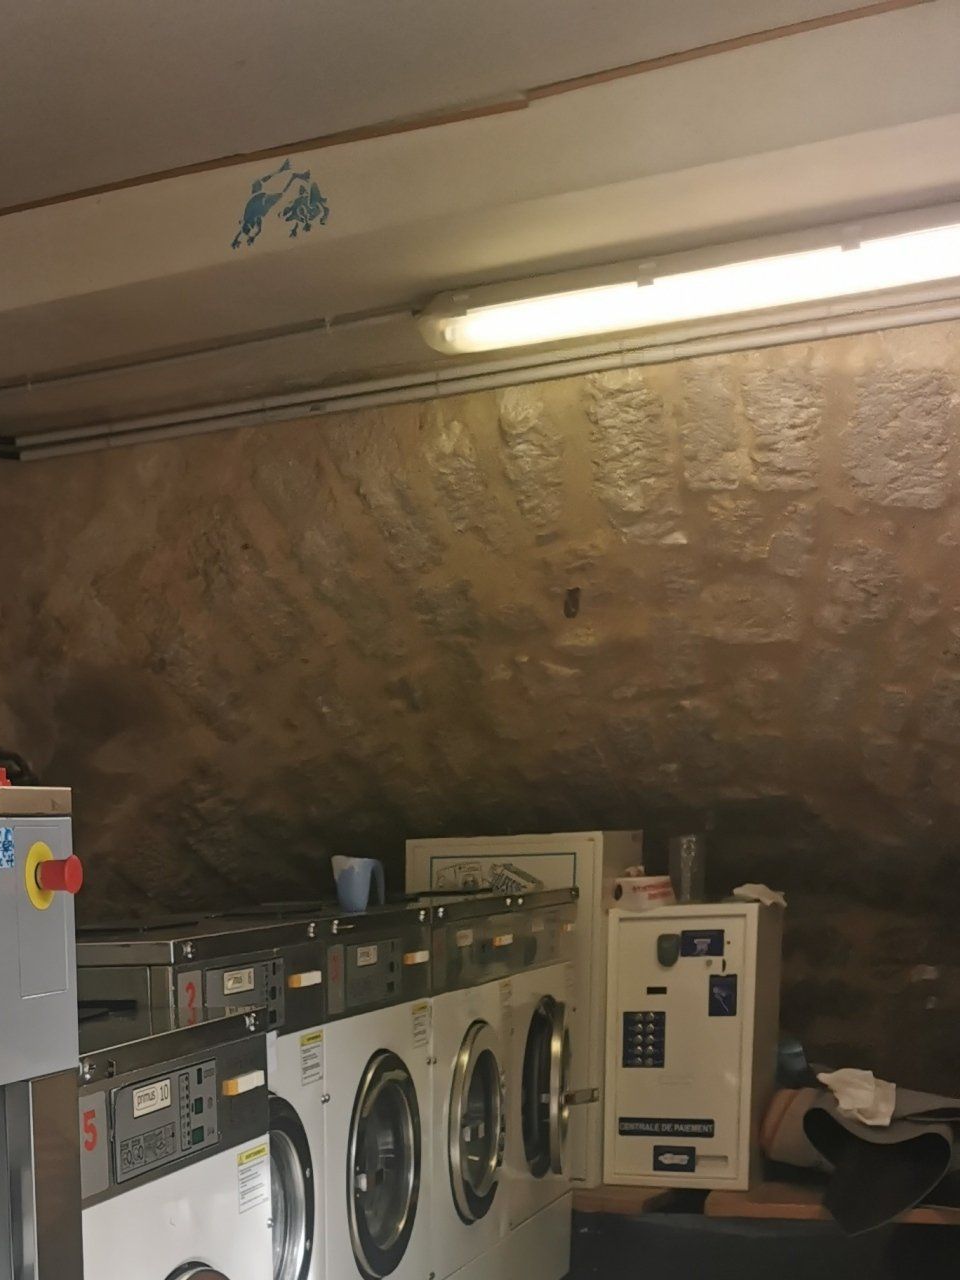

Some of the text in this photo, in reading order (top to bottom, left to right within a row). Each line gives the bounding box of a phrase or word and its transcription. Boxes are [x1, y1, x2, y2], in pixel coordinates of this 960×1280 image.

[159, 1083, 169, 1102] 10
[83, 1109, 98, 1152] 5
[661, 1122, 673, 1133] DE
